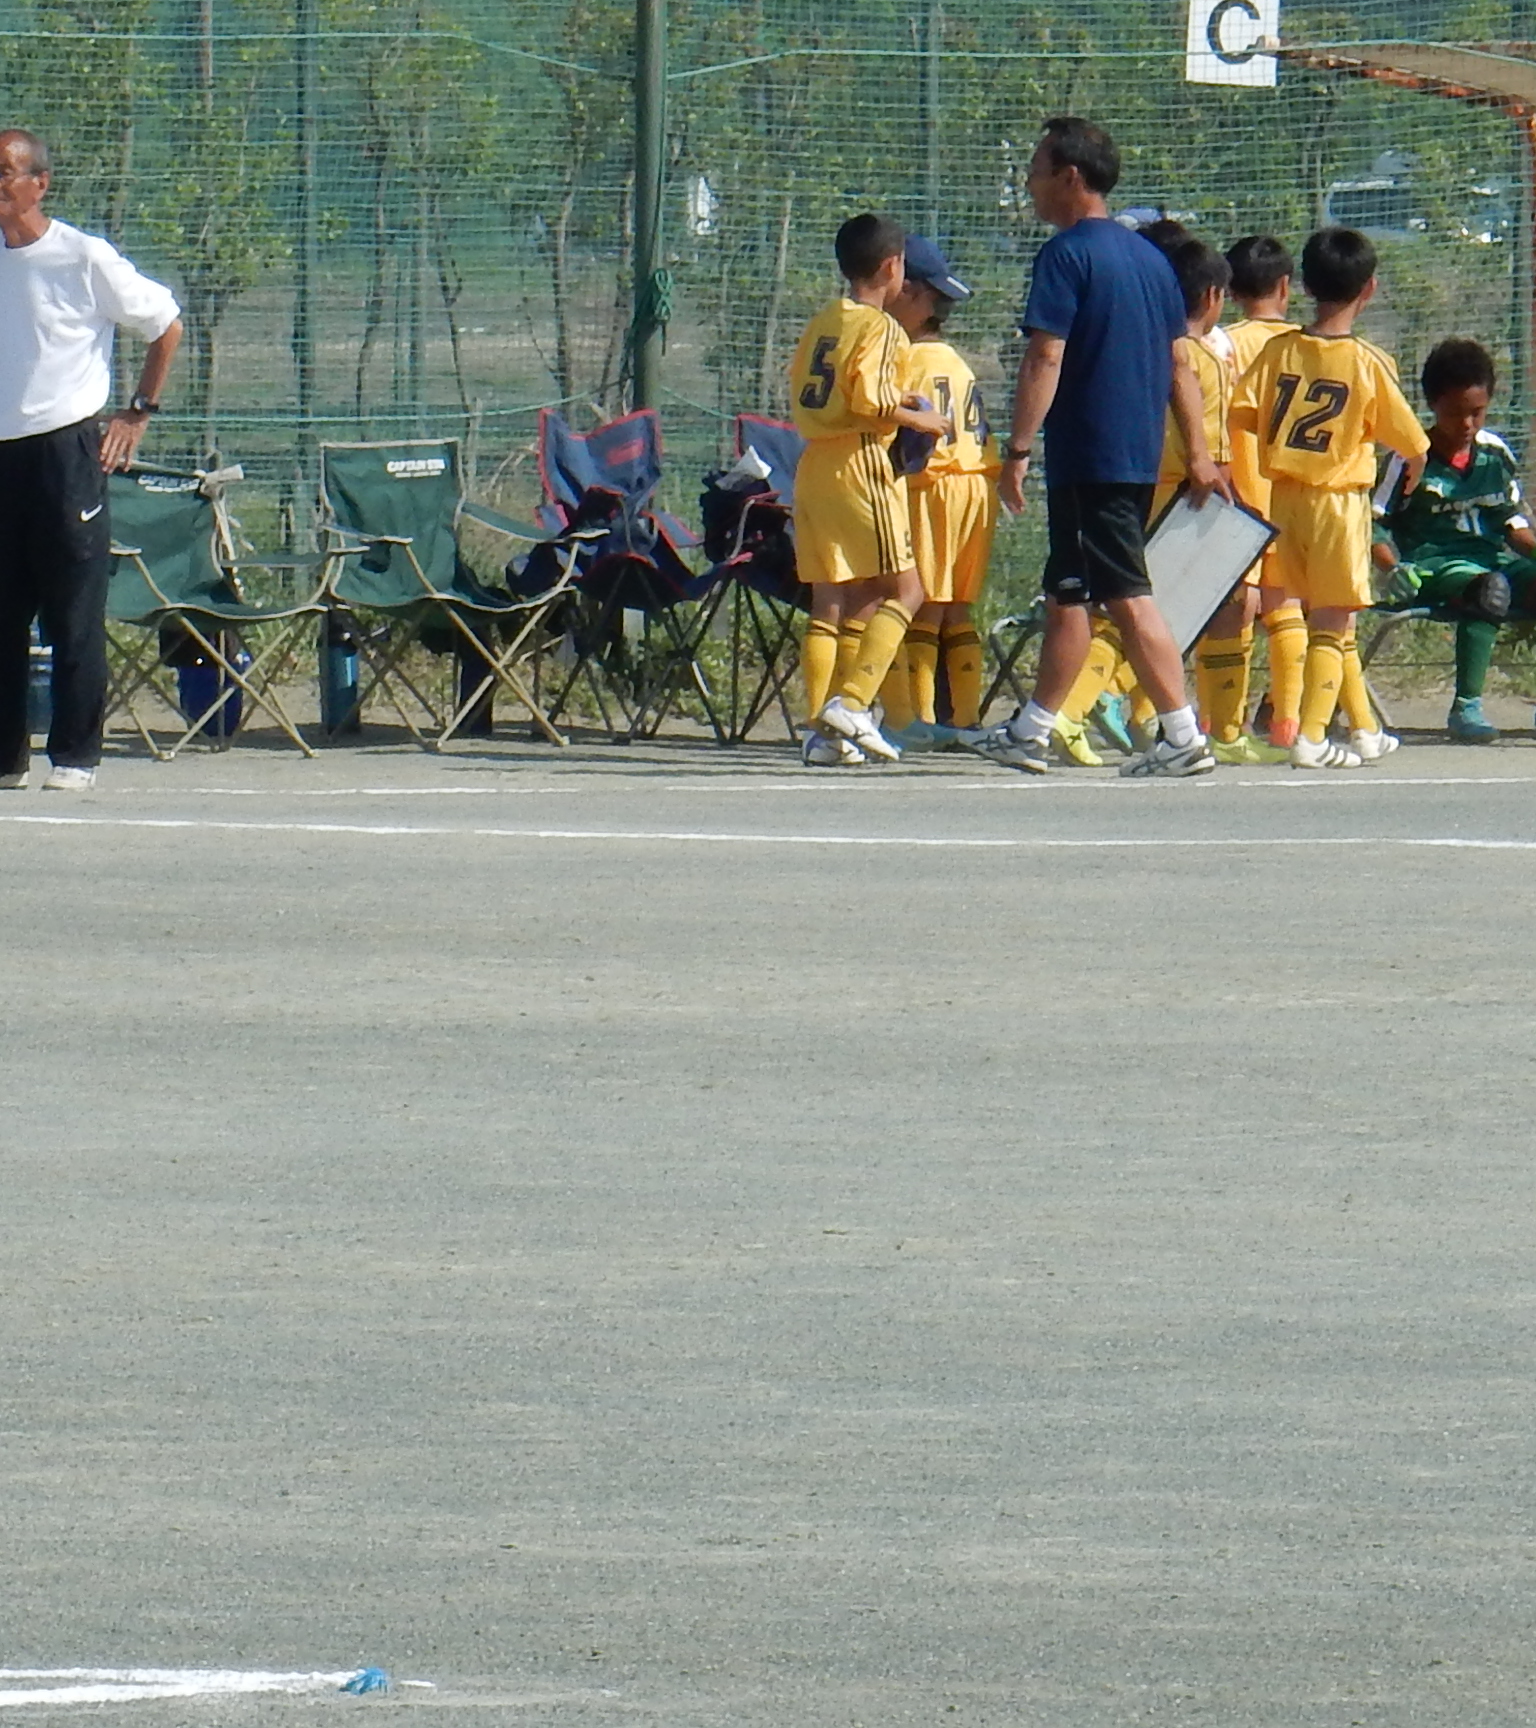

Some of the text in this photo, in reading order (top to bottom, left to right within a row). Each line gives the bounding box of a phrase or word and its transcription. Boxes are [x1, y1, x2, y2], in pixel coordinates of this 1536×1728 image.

[799, 335, 840, 409] 5
[933, 376, 991, 447] 14
[1267, 372, 1350, 453] 12
